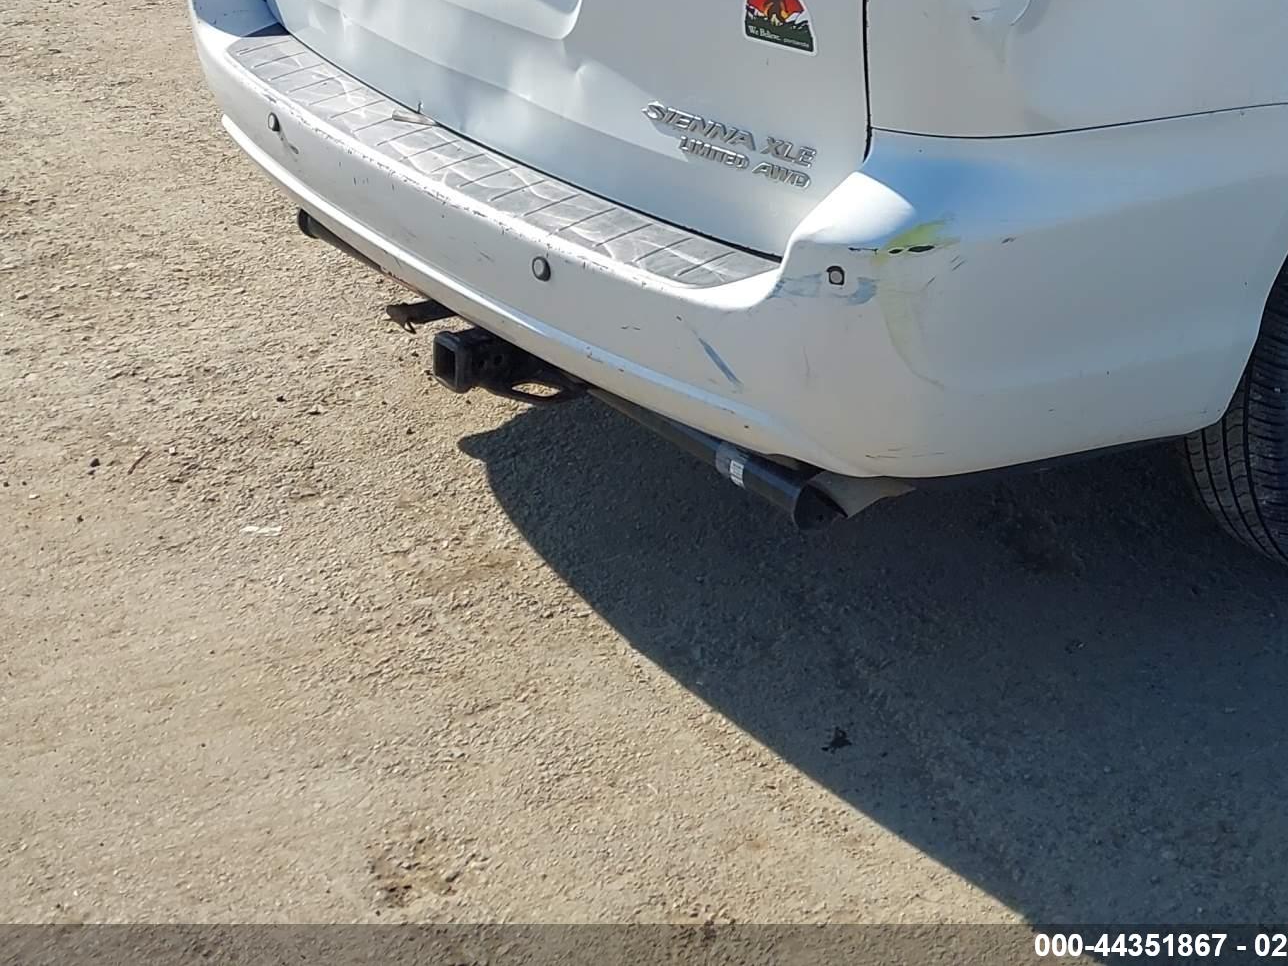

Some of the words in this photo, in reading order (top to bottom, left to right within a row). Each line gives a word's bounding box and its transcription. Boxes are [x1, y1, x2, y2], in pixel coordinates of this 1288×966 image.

[642, 101, 756, 151] SIENNA
[760, 137, 817, 168] XLE
[679, 136, 750, 170] LIMITED
[752, 161, 812, 189] AWD
